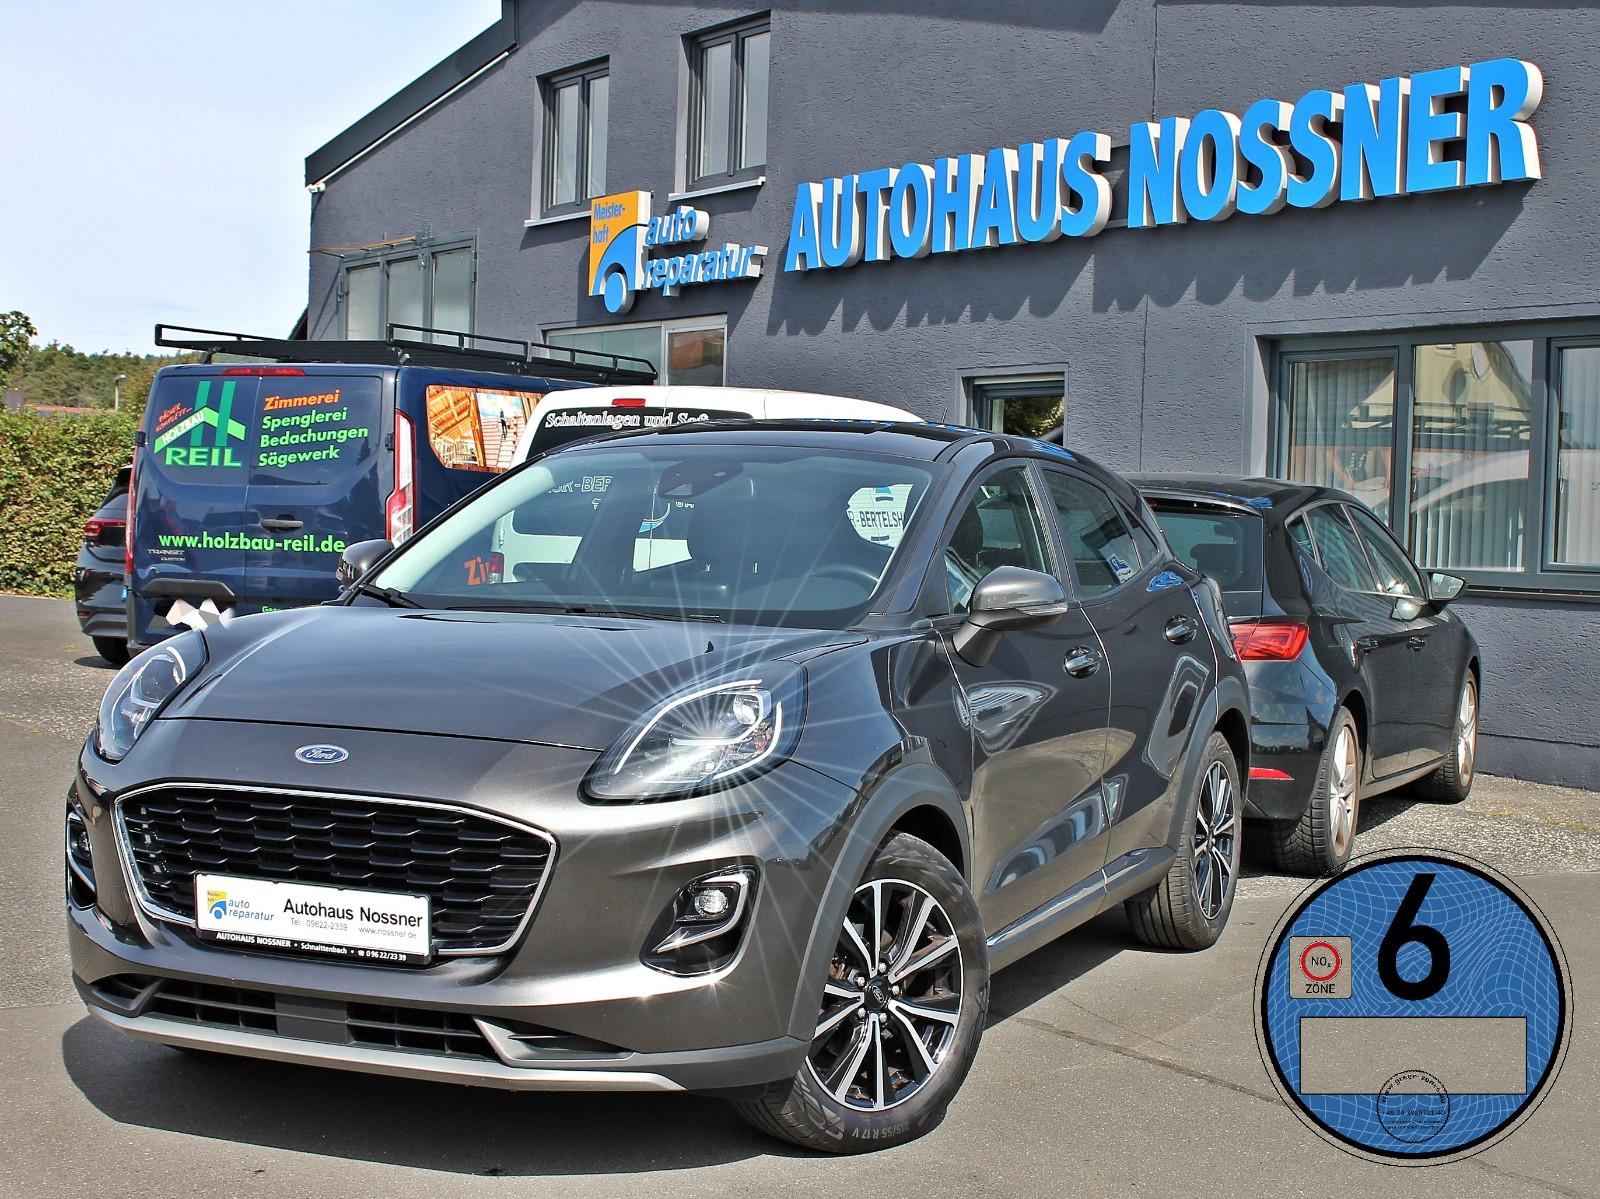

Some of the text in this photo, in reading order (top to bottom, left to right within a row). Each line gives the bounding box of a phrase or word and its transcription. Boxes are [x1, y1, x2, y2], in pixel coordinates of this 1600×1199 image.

[784, 57, 1540, 272] AUTOHAUS NOSSNER
[645, 206, 704, 245] auto
[643, 245, 758, 296] reparatur
[263, 389, 340, 411] Zimmerei
[161, 410, 205, 446] HOLZBAU
[262, 406, 348, 432] Spenglerei
[545, 411, 640, 430] Schaltanlagen
[643, 411, 674, 427] und
[260, 428, 369, 448] Bedachungen
[165, 447, 242, 467] REIL
[258, 445, 340, 468] Sägewerk
[158, 531, 345, 554] www.holzbau-reil.de
[306, 747, 337, 760] Ford
[228, 900, 250, 909] auto
[228, 908, 275, 921] reparatur
[284, 898, 423, 927] Autohaus Nossner
[216, 932, 255, 943] AUTOHAUS
[256, 938, 291, 948] NOSSNER
[301, 942, 348, 955] Schnaittenbach
[358, 926, 417, 939] www.nossner.de
